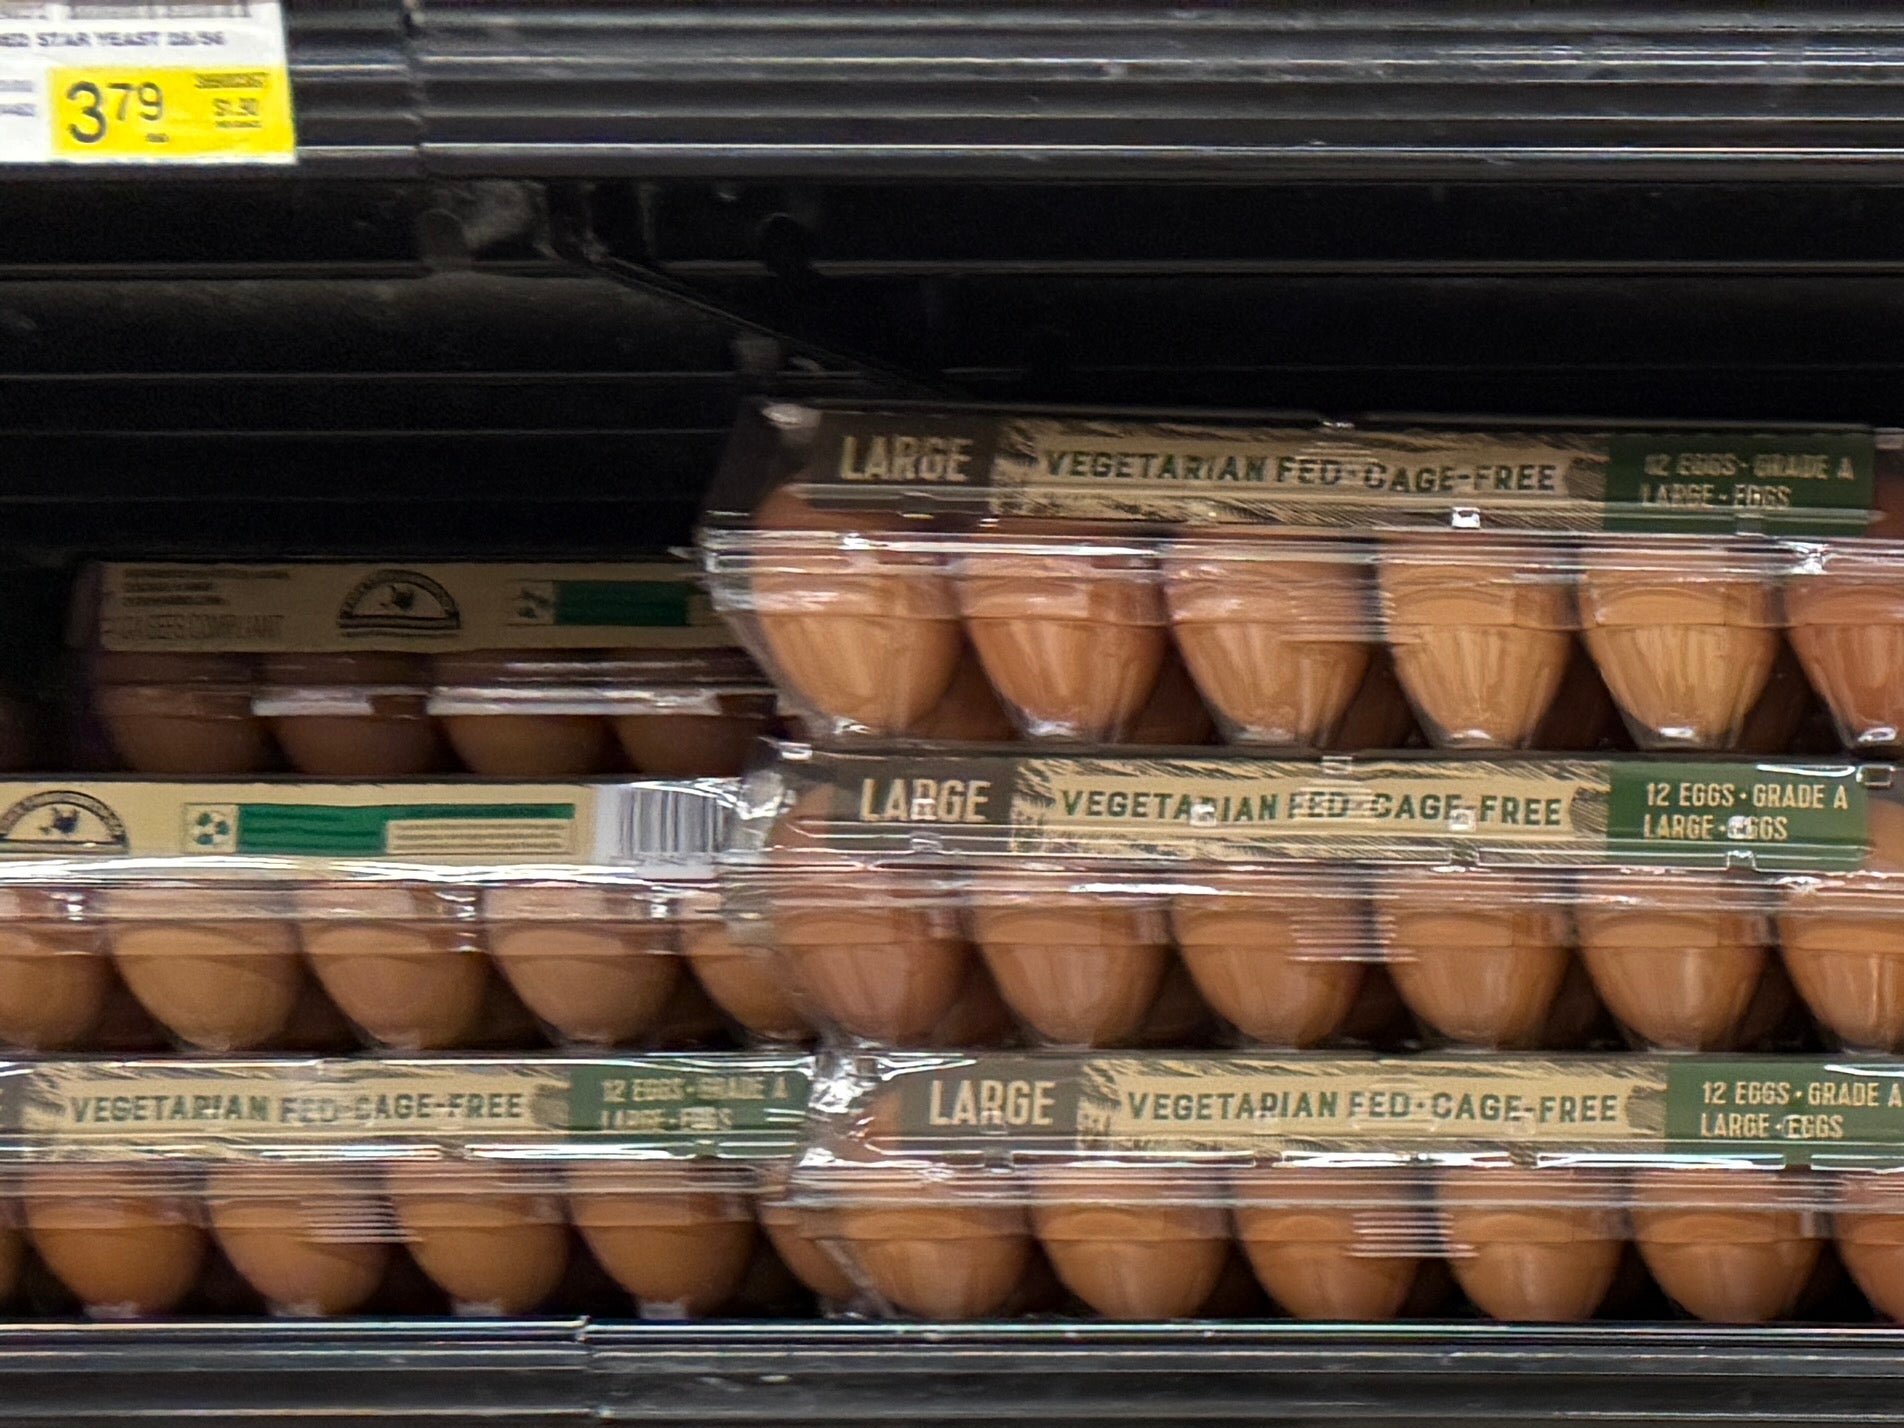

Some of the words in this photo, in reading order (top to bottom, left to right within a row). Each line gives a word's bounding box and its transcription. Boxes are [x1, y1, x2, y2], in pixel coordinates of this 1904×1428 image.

[841, 435, 972, 483] LARGE
[1045, 451, 1266, 484] VEGETARIAN
[861, 778, 992, 822] LARGE
[1646, 783, 1670, 806] 12
[1679, 783, 1735, 806] EGGS
[1752, 784, 1825, 809] GRADE
[1833, 785, 1848, 809] A
[1643, 814, 1714, 839] LARGE
[928, 1080, 1056, 1126] LARGE
[1127, 1090, 1334, 1122] VEGETARIAN
[1346, 1091, 1410, 1119] FED
[1432, 1091, 1618, 1124] CAGE-FREE
[1702, 1082, 1727, 1104] 12
[1735, 1082, 1790, 1104] EGGS
[1808, 1083, 1879, 1106] GRADE
[1888, 1083, 1903, 1107] A
[70, 1097, 268, 1123] VEGETARIAN
[1700, 1113, 1770, 1137] LARGE
[1787, 1115, 1844, 1138] EGGS
